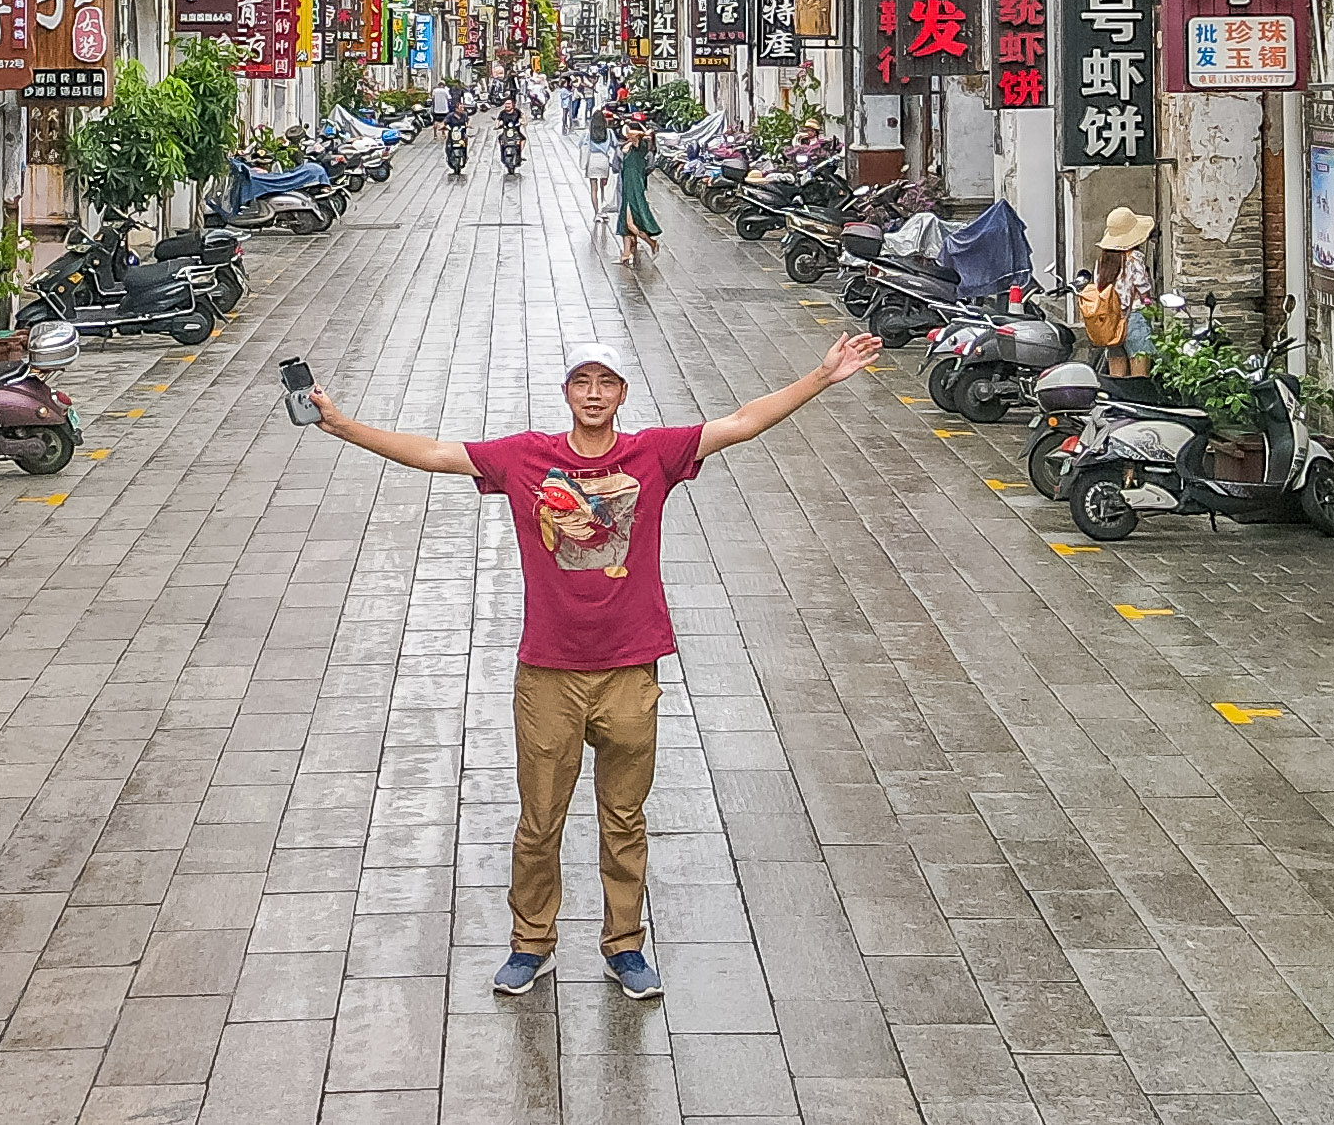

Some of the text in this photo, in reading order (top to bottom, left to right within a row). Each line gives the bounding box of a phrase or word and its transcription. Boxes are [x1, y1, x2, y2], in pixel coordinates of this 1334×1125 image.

[79, 11, 101, 58] 女装
[1195, 23, 1218, 68] 批发
[1224, 19, 1287, 44] 珍珠
[1225, 45, 1287, 69] 玉镯
